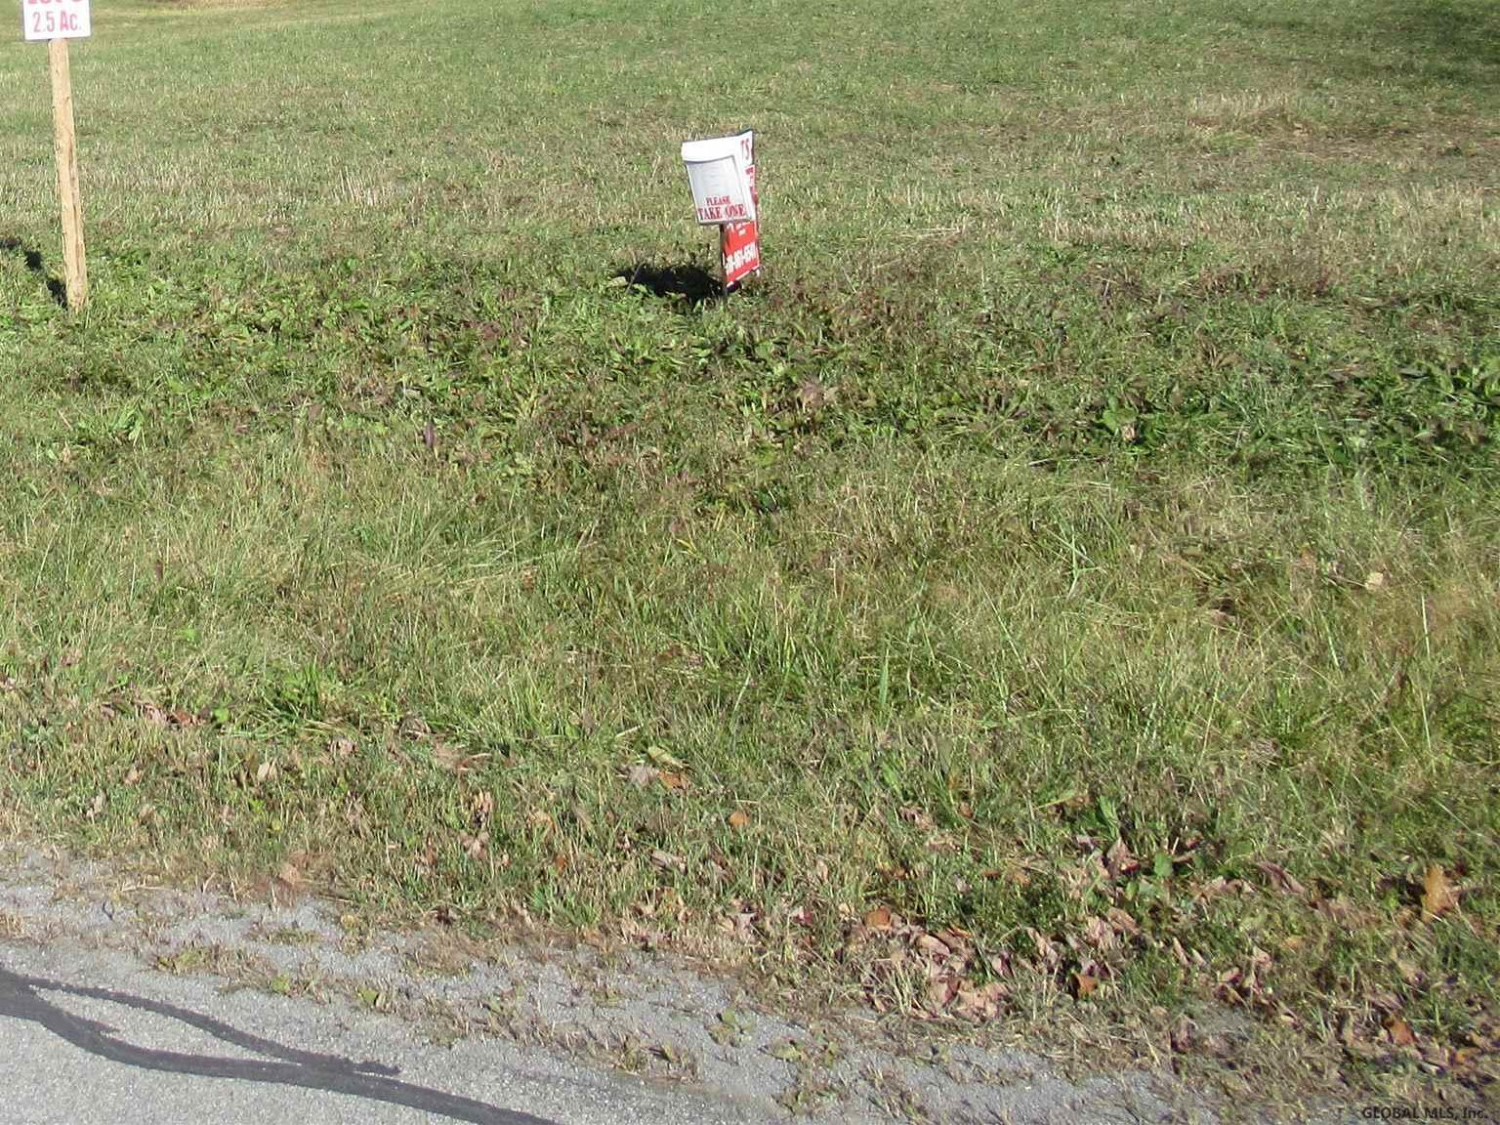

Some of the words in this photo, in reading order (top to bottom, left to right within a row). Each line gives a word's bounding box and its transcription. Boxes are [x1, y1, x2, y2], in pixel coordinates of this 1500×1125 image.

[705, 195, 731, 206] PLEASE
[698, 206, 722, 220] TAKE
[725, 203, 746, 218] ONE
